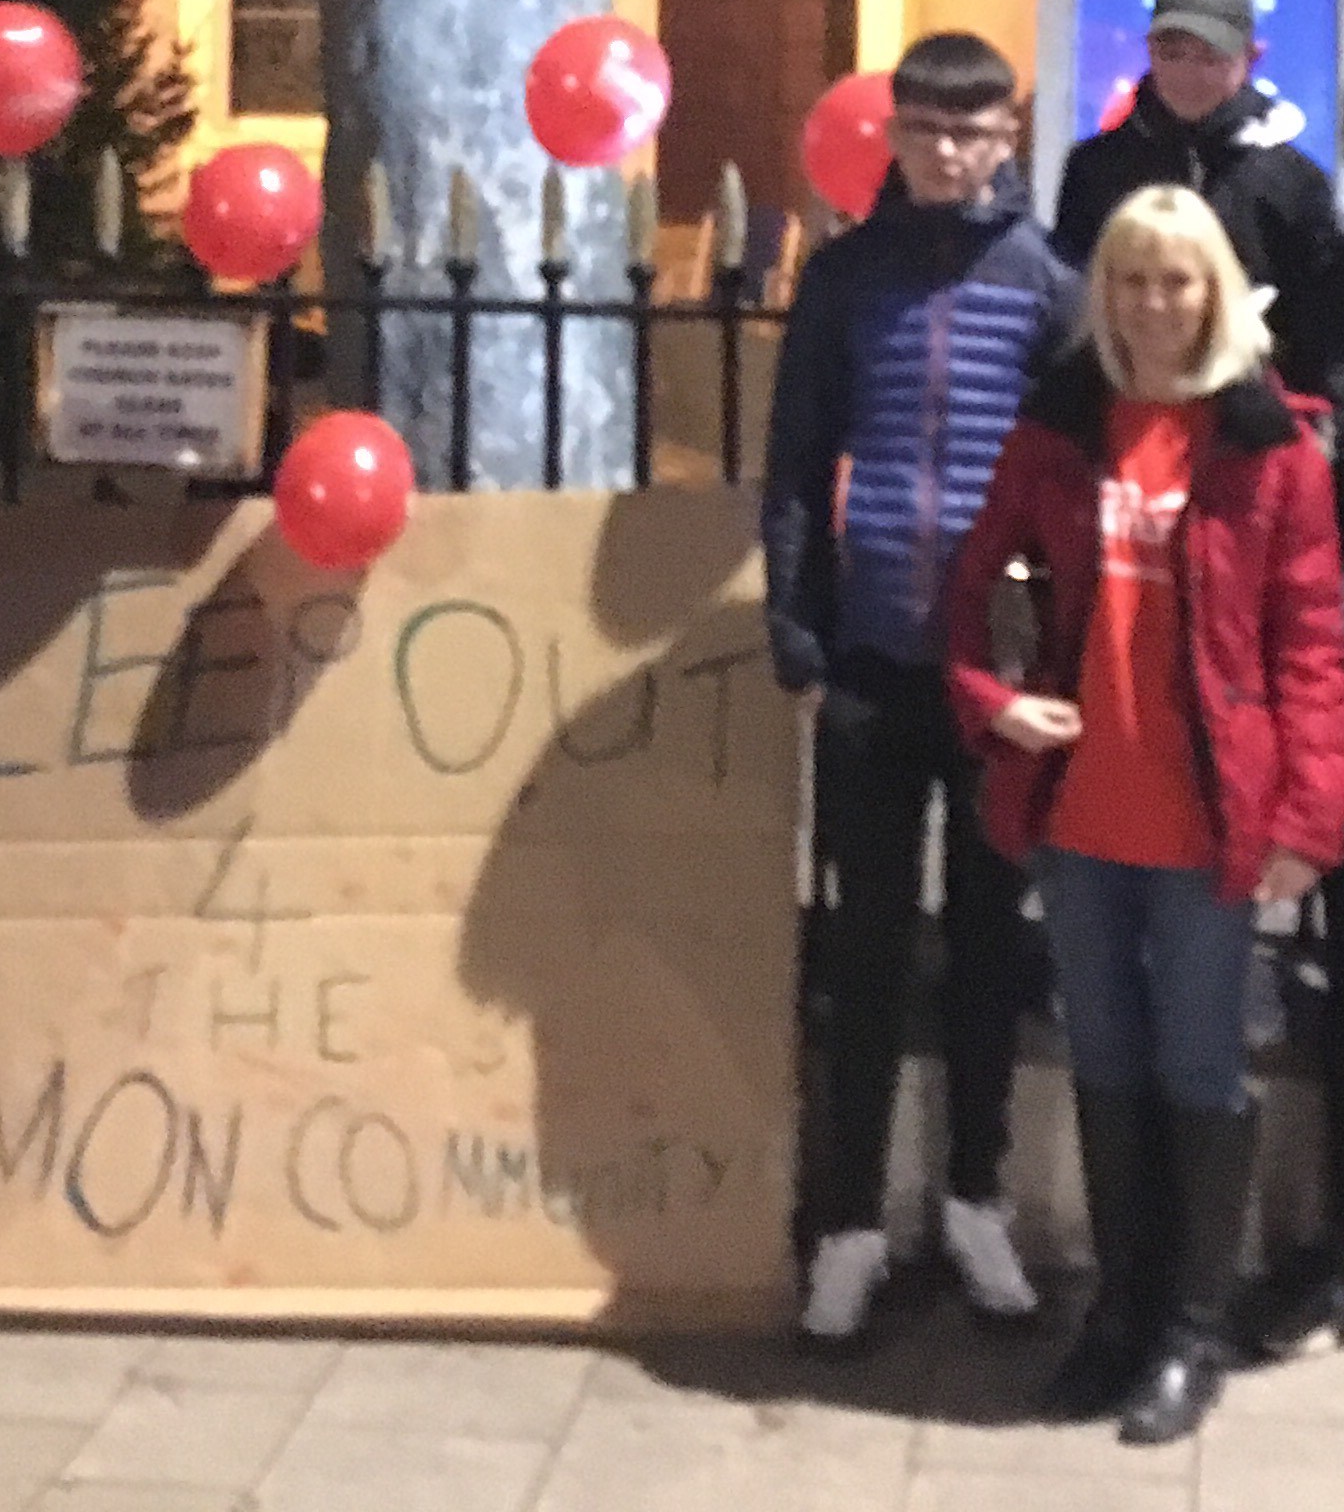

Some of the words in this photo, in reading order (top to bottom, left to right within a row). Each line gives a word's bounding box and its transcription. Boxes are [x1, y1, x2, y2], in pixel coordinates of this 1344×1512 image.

[394, 598, 760, 788] OUT
[193, 812, 312, 976] 4
[122, 964, 373, 1064] THE
